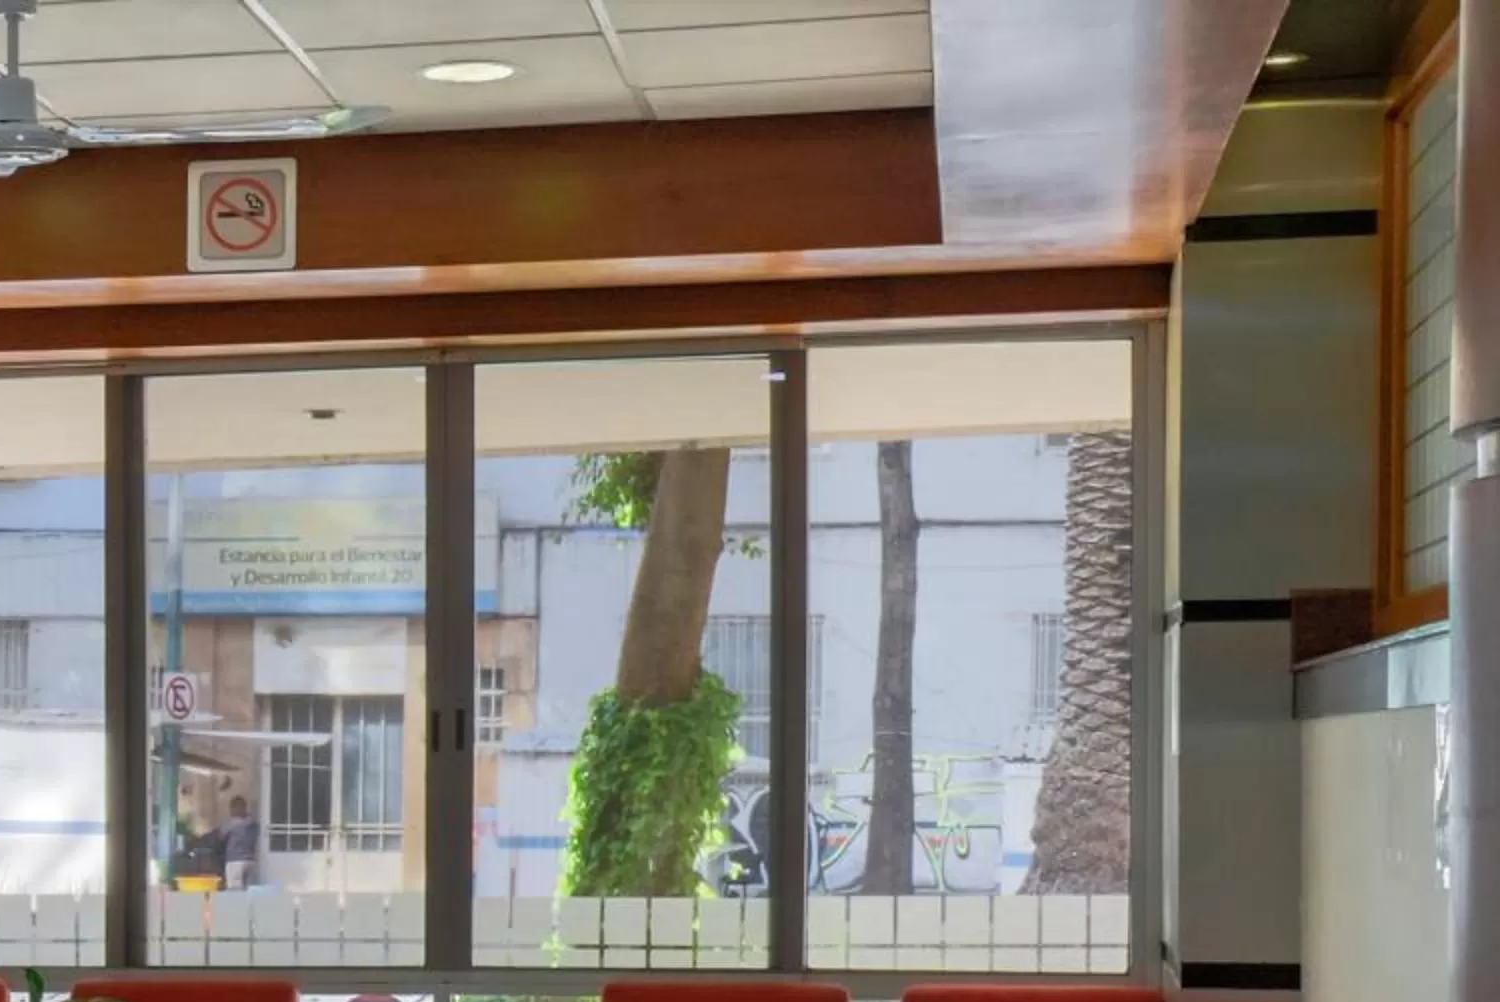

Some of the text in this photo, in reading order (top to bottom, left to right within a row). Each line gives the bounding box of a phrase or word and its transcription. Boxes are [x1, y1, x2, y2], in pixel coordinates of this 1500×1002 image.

[219, 546, 422, 566] Estancia para el Bienestar
[229, 573, 241, 587] y
[244, 568, 326, 585] Desarrollo
[330, 567, 388, 584] Infantil
